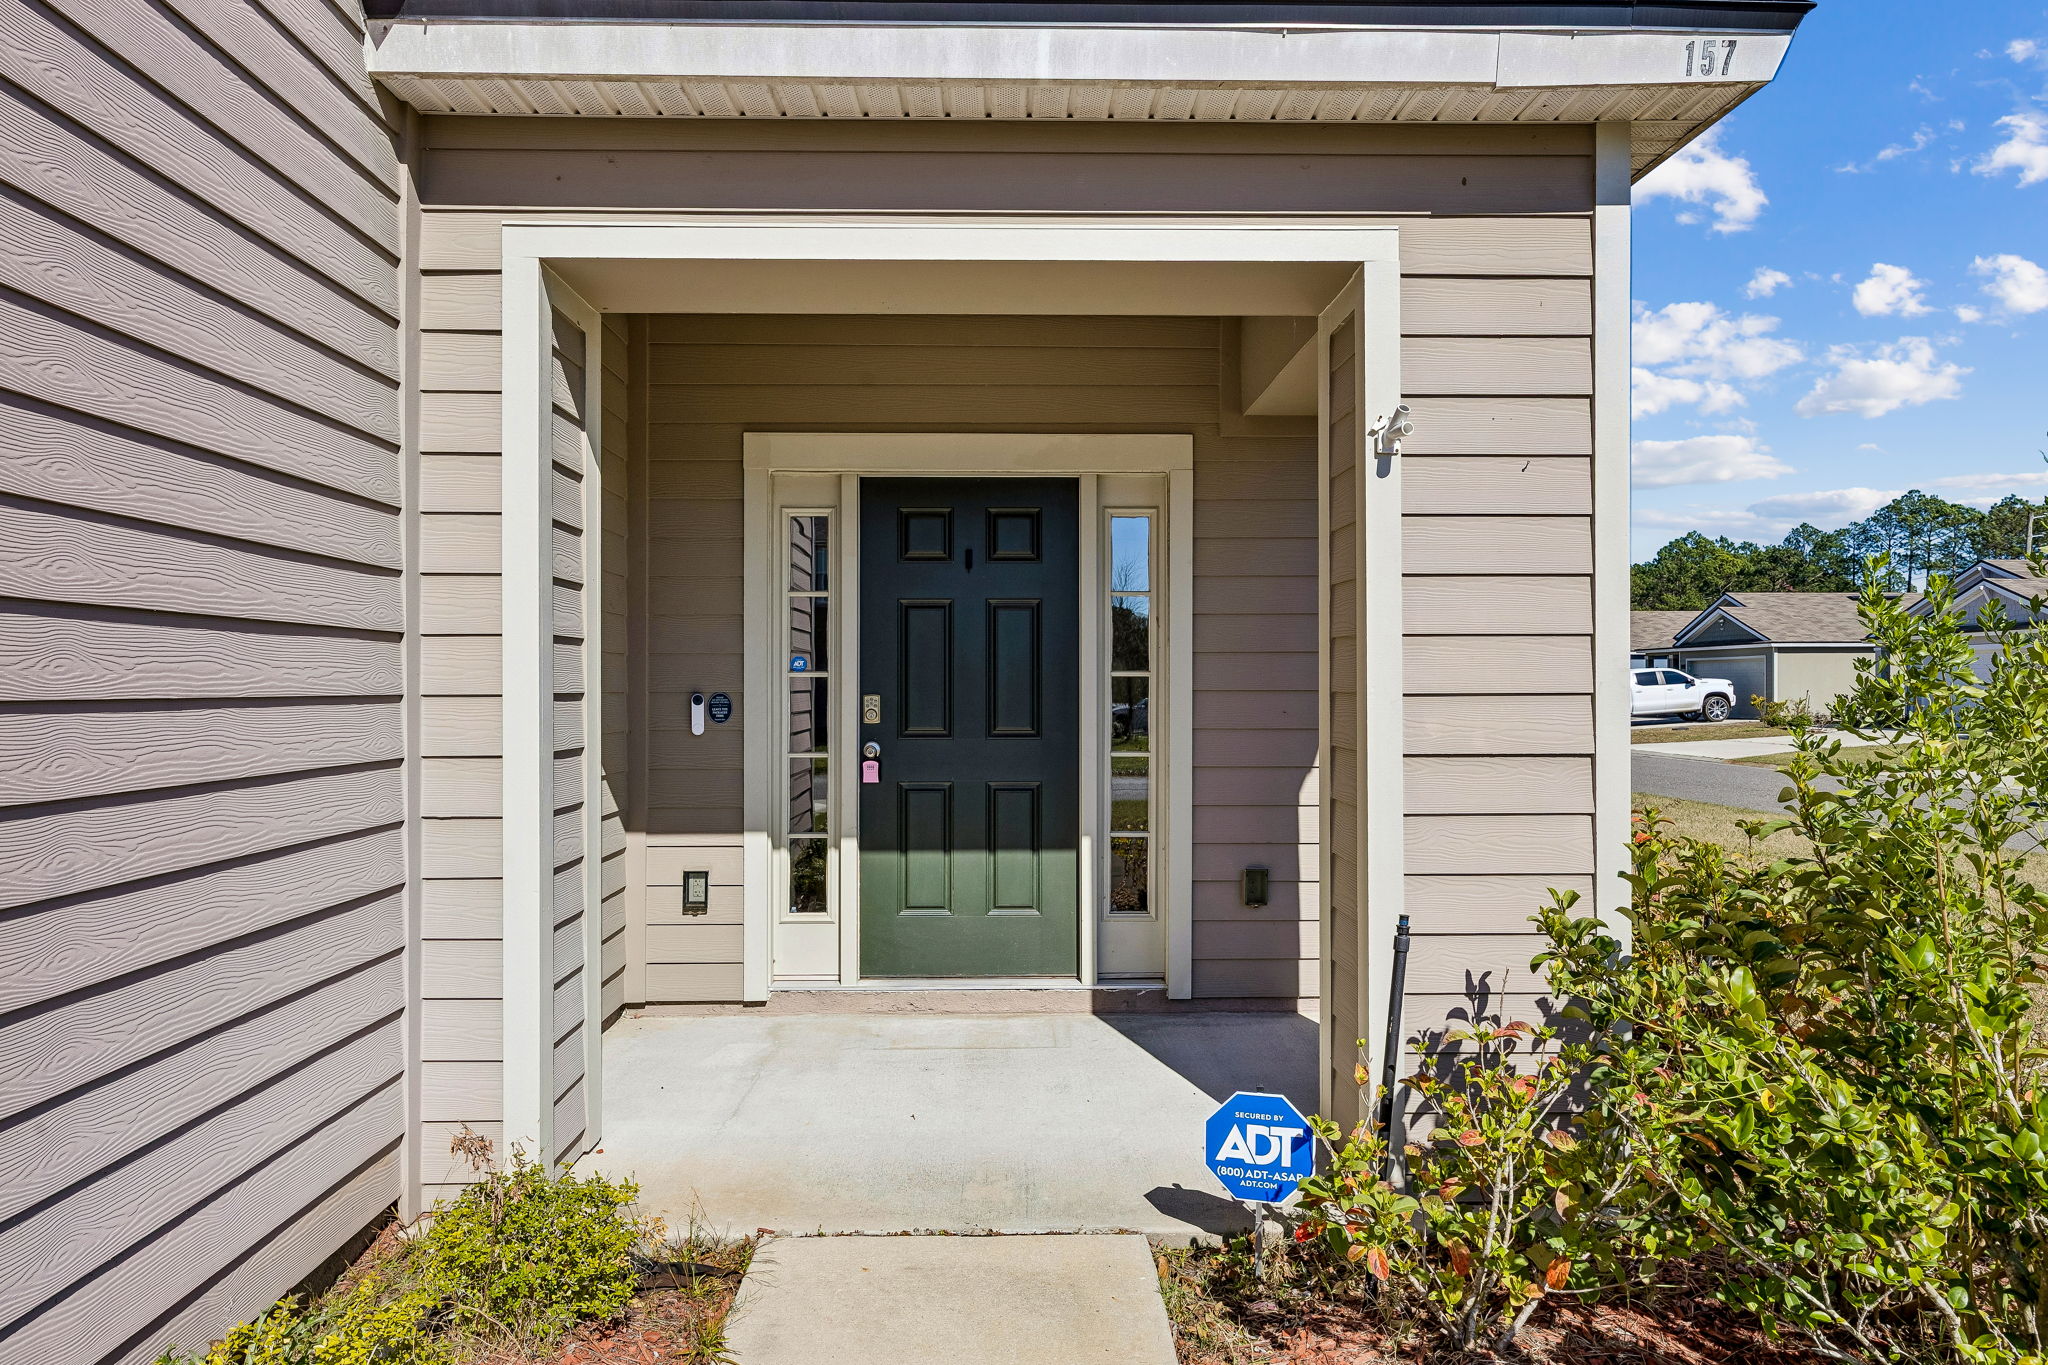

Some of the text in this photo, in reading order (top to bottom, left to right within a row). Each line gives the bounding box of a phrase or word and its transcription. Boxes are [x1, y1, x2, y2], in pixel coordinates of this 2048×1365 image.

[1685, 39, 1738, 76] 157
[1235, 1112, 1284, 1122] SECURED BY
[1215, 1123, 1304, 1168] ADT
[1217, 1165, 1304, 1182] (800) ADT-ASAP
[1240, 1180, 1277, 1189] ADT.COM
